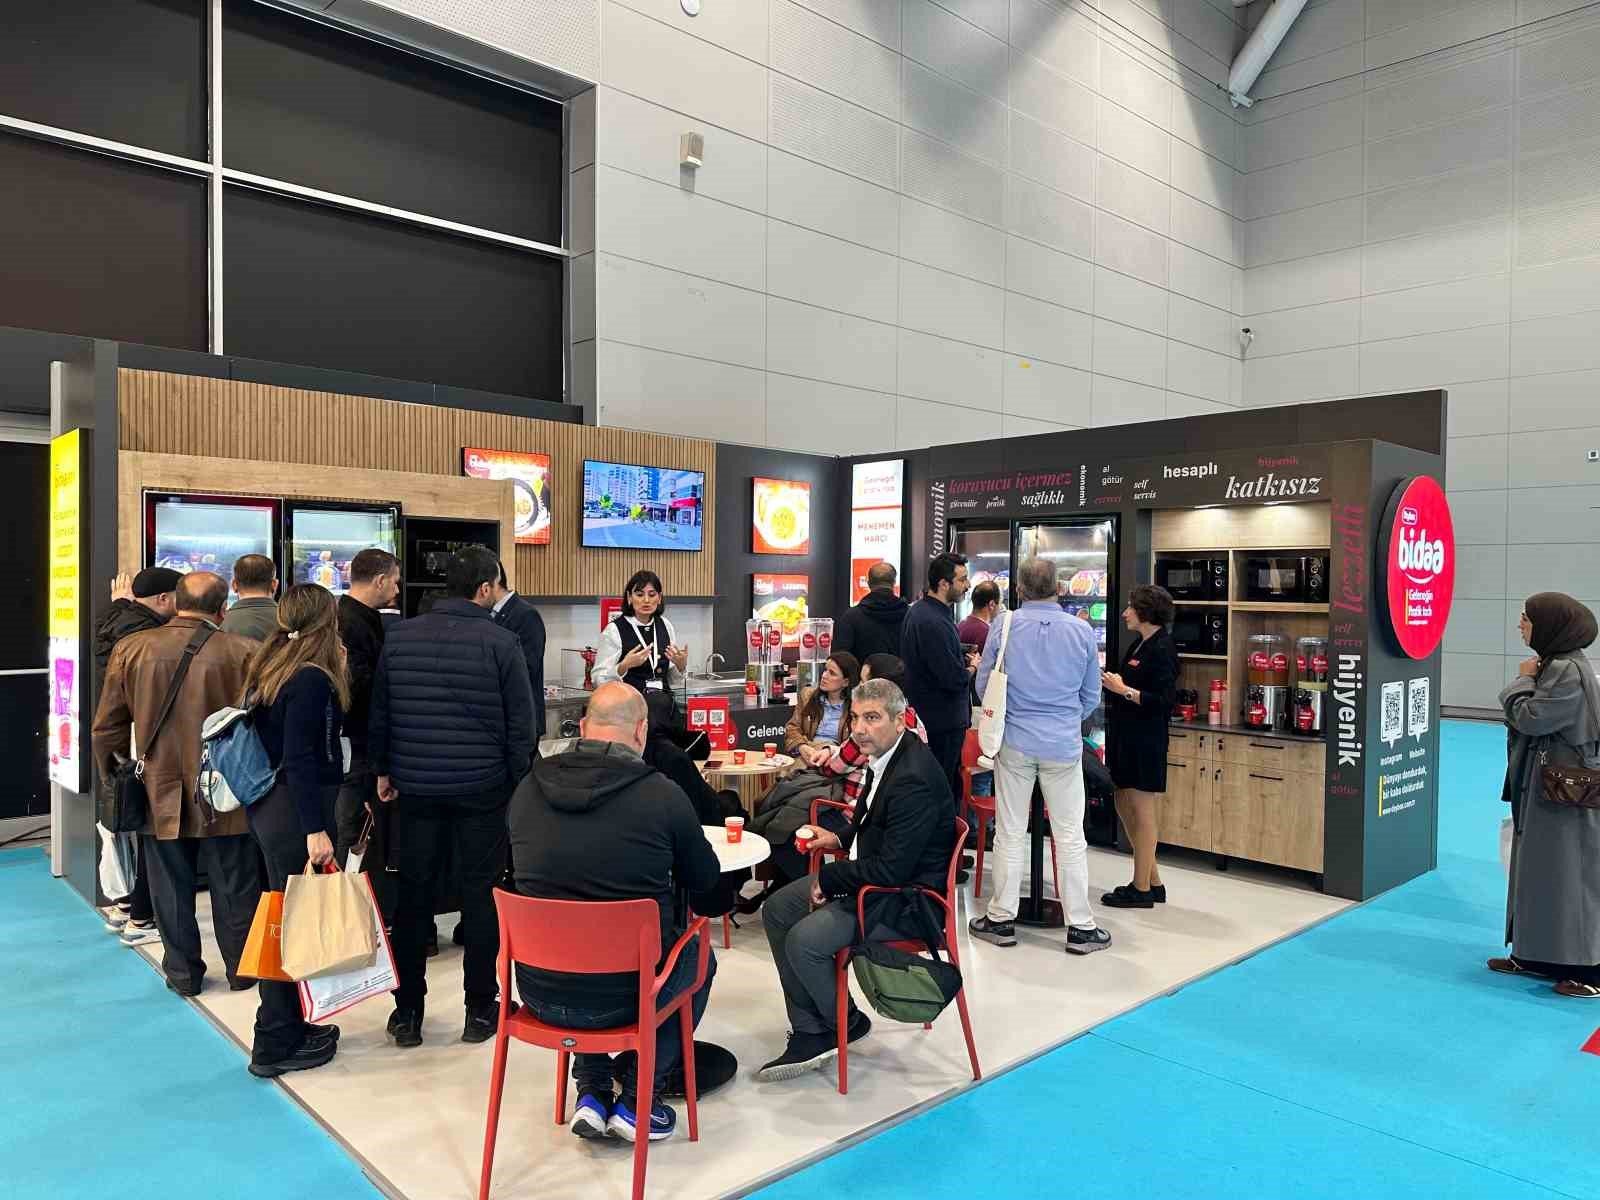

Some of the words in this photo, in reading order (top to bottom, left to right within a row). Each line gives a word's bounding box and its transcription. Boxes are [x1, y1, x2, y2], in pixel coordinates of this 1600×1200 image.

[1102, 465, 1110, 473] al
[1163, 462, 1218, 478] hesaplı
[1015, 472, 1073, 492] içermez
[1079, 464, 1087, 507] ekonomik
[1102, 475, 1123, 486] götür
[1224, 473, 1323, 499] katkısız
[1021, 490, 1065, 507] sağlıklı
[929, 481, 945, 560] konomik
[1398, 527, 1445, 575] bidaa
[1333, 654, 1363, 767] hijyenik
[747, 724, 786, 738] Gelene
